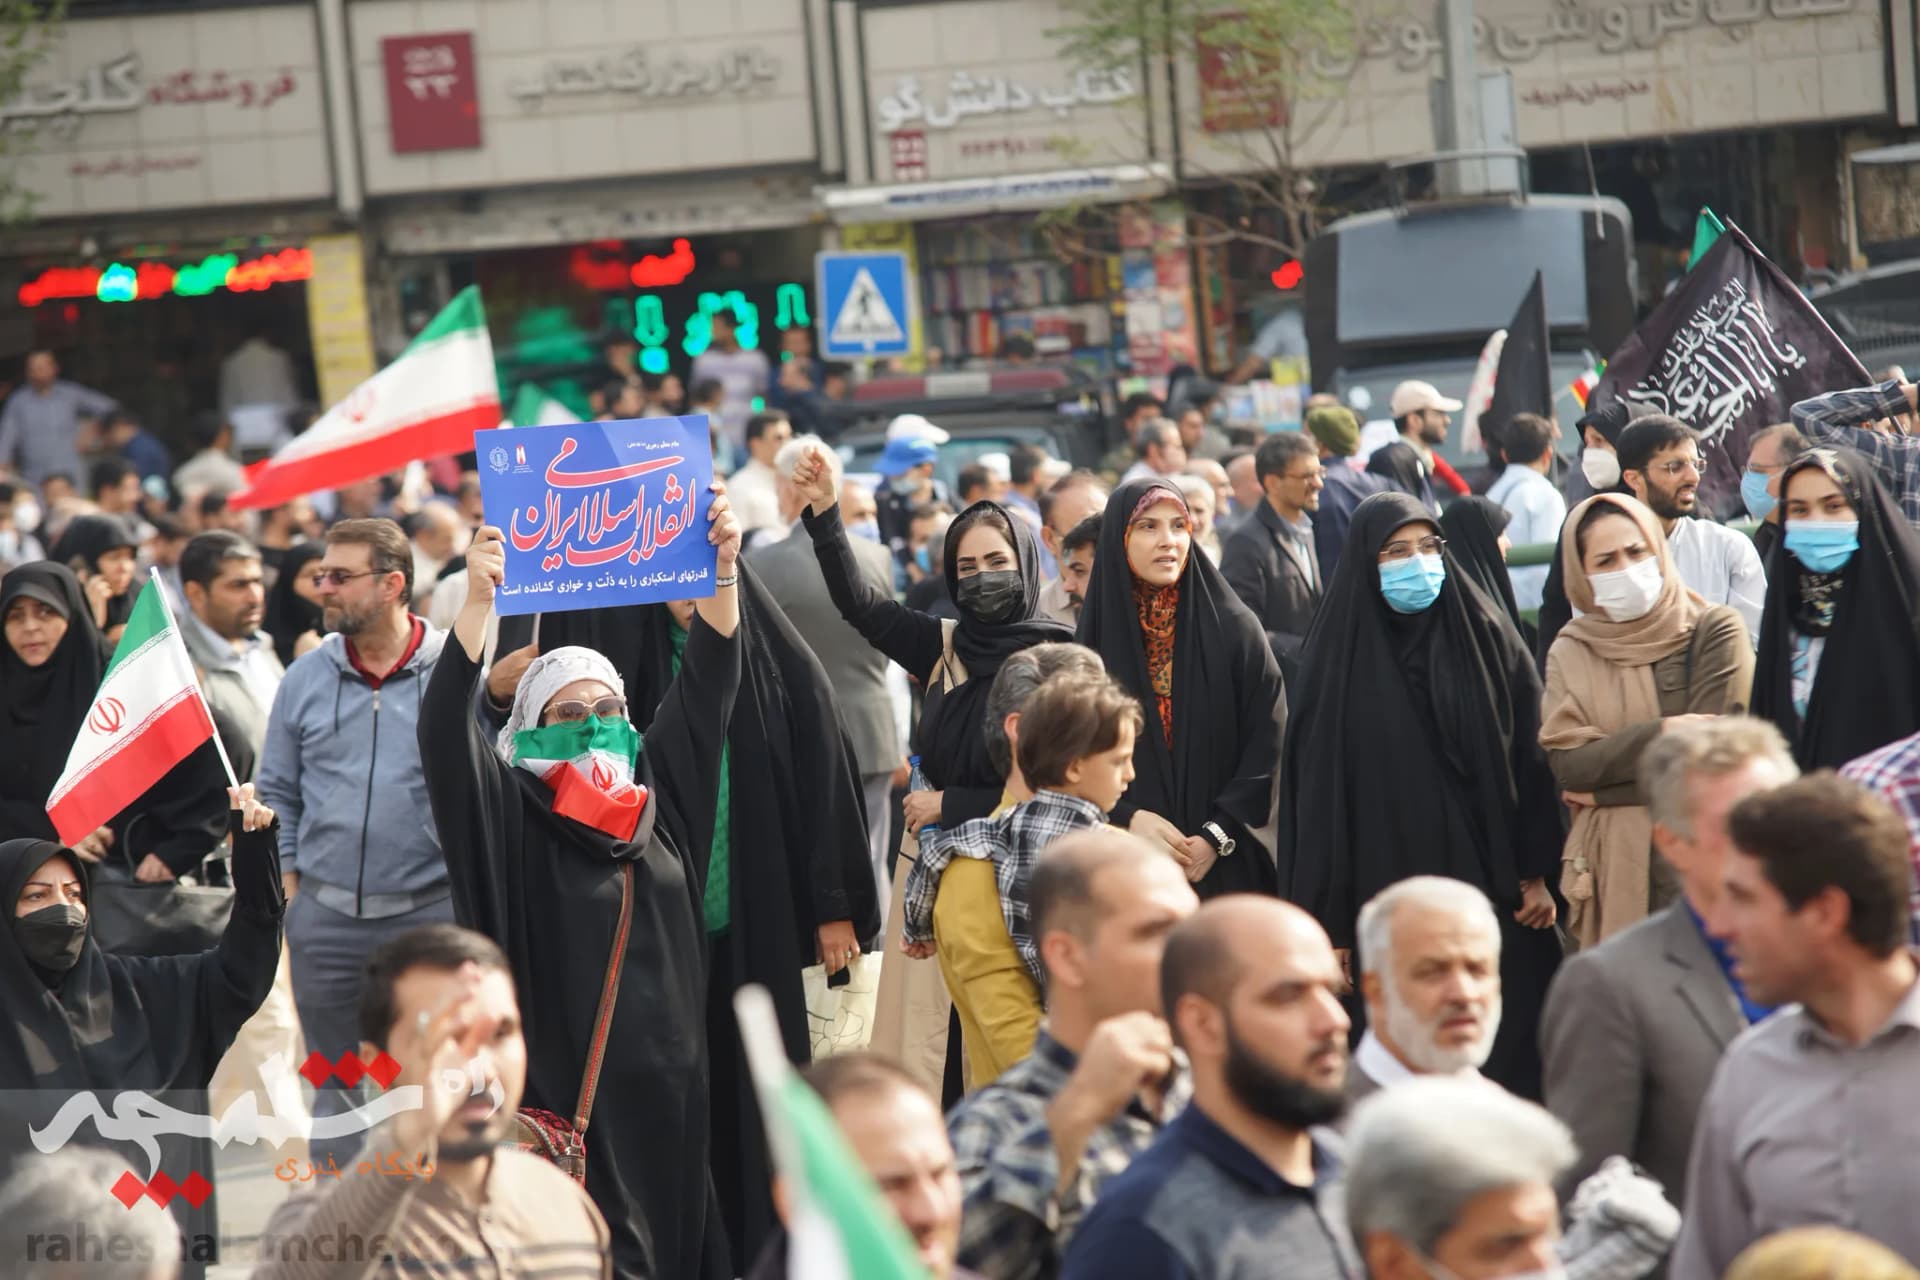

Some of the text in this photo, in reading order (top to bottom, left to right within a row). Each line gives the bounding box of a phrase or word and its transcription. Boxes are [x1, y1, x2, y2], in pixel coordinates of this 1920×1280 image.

[510, 437, 697, 573] انقلاب اسلامی ایران
[630, 574, 638, 588] را
[639, 570, 676, 587] استکباری
[677, 567, 708, 584] قدرتهای
[501, 583, 522, 596] است
[523, 580, 554, 594] کشانده
[557, 579, 584, 593] خواری
[586, 581, 593, 591] و
[617, 577, 628, 589] به
